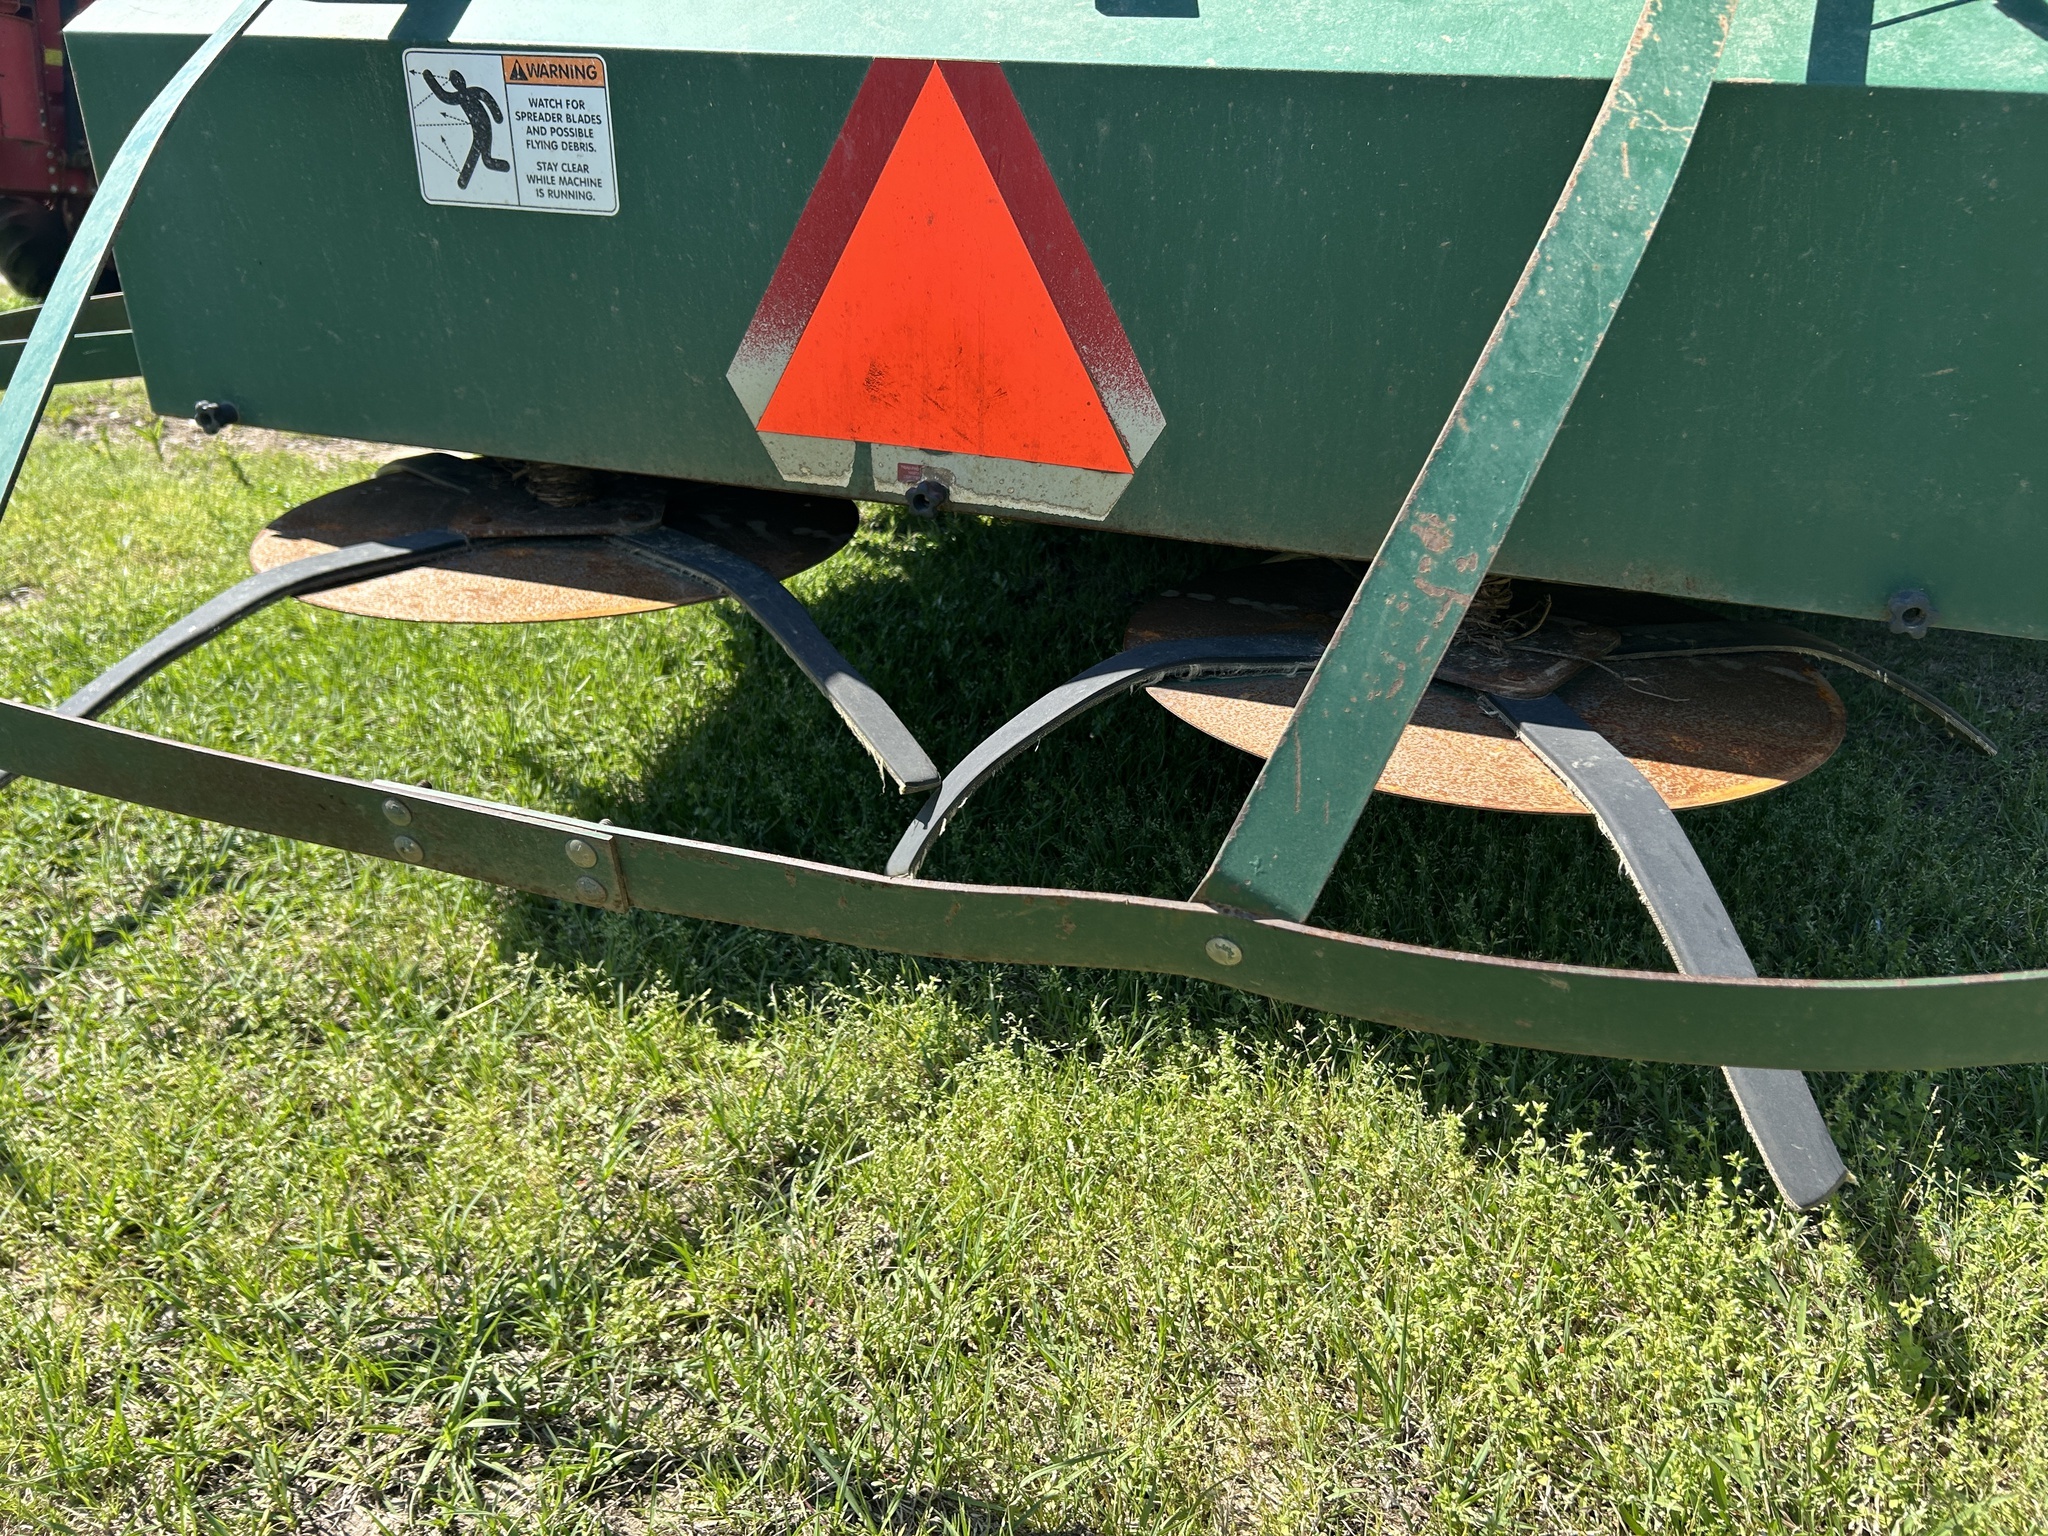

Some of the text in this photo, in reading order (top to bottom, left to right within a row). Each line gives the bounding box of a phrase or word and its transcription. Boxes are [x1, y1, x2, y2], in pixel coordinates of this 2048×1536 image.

[526, 63, 597, 80] WARNING
[528, 98, 585, 110] WATCH FOR
[515, 111, 602, 125] SPREADER BLADES
[526, 125, 594, 138] AND POSSIBLE
[526, 139, 597, 152] FLYING DEBRIS.
[536, 161, 589, 174] STAY CLEAR
[526, 174, 602, 188] WHILE MACHINE
[536, 188, 595, 201] IS RUNNING.
